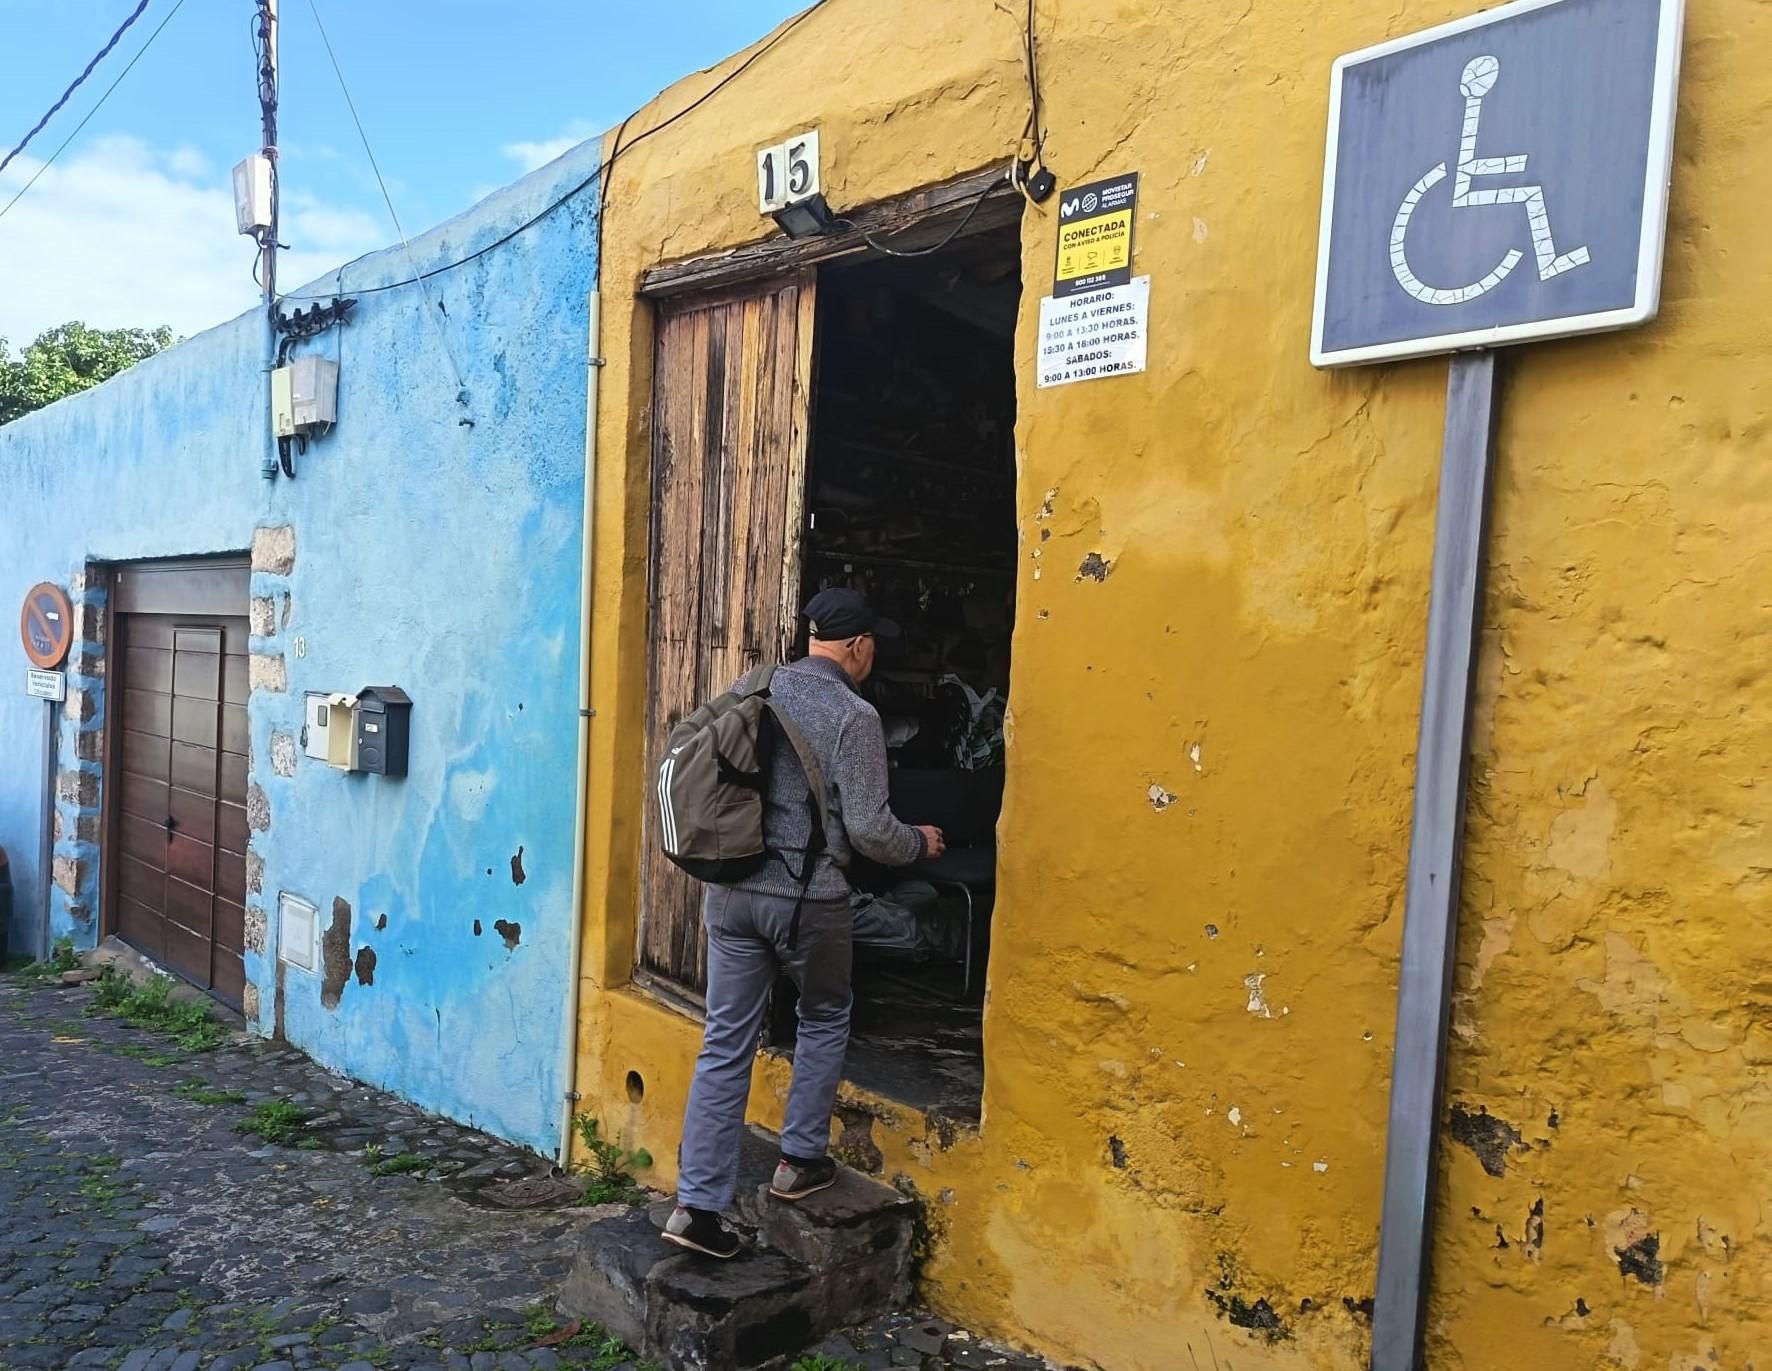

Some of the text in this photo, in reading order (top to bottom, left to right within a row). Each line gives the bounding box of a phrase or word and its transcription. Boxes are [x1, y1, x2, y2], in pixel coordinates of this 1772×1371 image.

[762, 142, 812, 202] 15
[1101, 189, 1134, 202] PROSEGUR
[1102, 183, 1132, 195] MOVISTAR
[1101, 197, 1127, 208] ALARMAS
[1063, 220, 1126, 242] CONECTADA
[1063, 242, 1076, 250] CON
[1077, 237, 1095, 247] AVISO
[1101, 231, 1125, 241] POLICÍA
[1070, 292, 1115, 308] HORARIO:
[1049, 302, 1135, 326] LUNES A VIERNES:
[1046, 316, 1139, 340] 9:00 A 13:30 HORAS.
[1043, 343, 1065, 355] 15:30
[1068, 342, 1074, 350] A
[1103, 331, 1140, 343] HORAS.
[1066, 350, 1112, 365] SABADOS:
[1044, 361, 1137, 383] 9:00 A 13:00 HORAS.
[294, 636, 306, 658] 13
